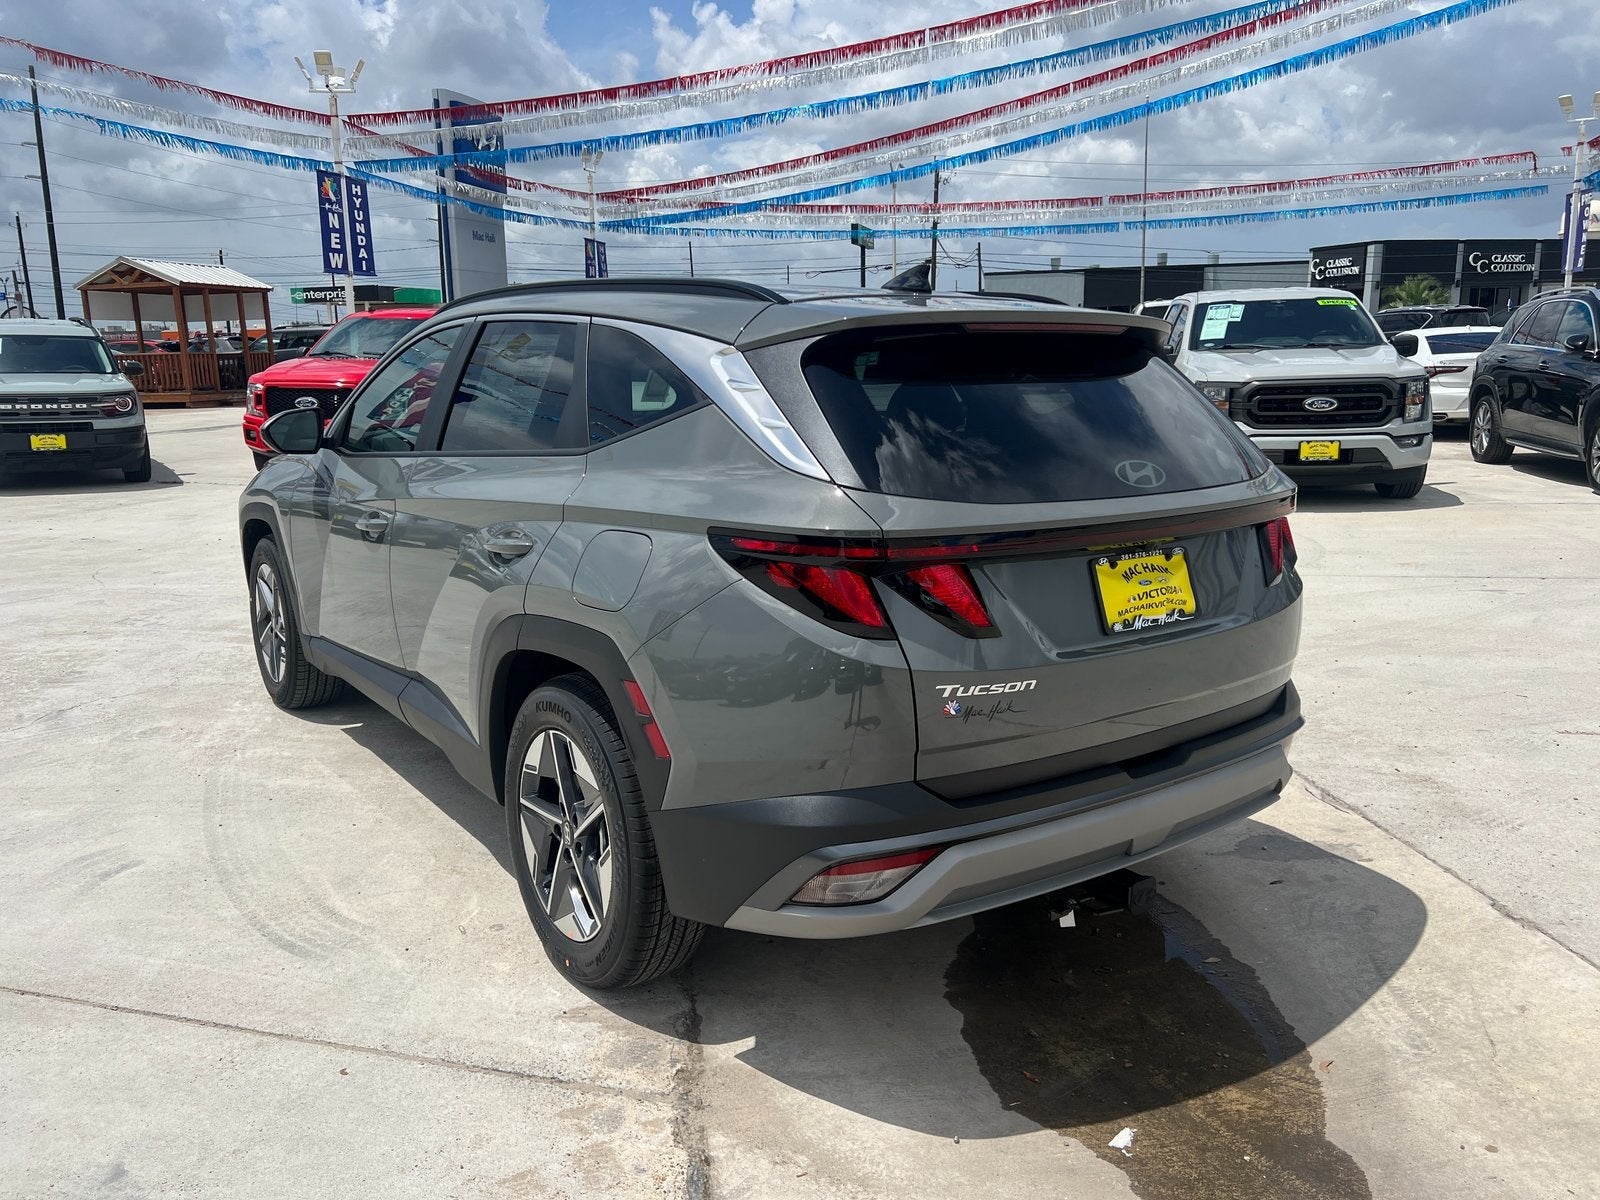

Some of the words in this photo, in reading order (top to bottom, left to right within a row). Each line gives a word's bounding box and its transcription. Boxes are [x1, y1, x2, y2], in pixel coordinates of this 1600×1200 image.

[351, 184, 368, 271] HYUNDAI
[328, 212, 343, 269] NEW
[472, 230, 484, 242] Mac
[1577, 206, 1589, 267] OWNED
[1326, 257, 1352, 268] CLASSIC
[1492, 254, 1526, 262] CLASSIC
[1325, 266, 1360, 277] COLLISION
[1490, 263, 1535, 272] COLLISION
[294, 288, 355, 300] enterpris
[1312, 400, 1330, 408] Ford
[1121, 563, 1141, 583] MAC
[1141, 562, 1174, 576] HAIK
[1132, 613, 1155, 631] Mac
[535, 700, 572, 724] KUMHO
[961, 705, 986, 724] Mac
[987, 700, 1018, 722] Haik
